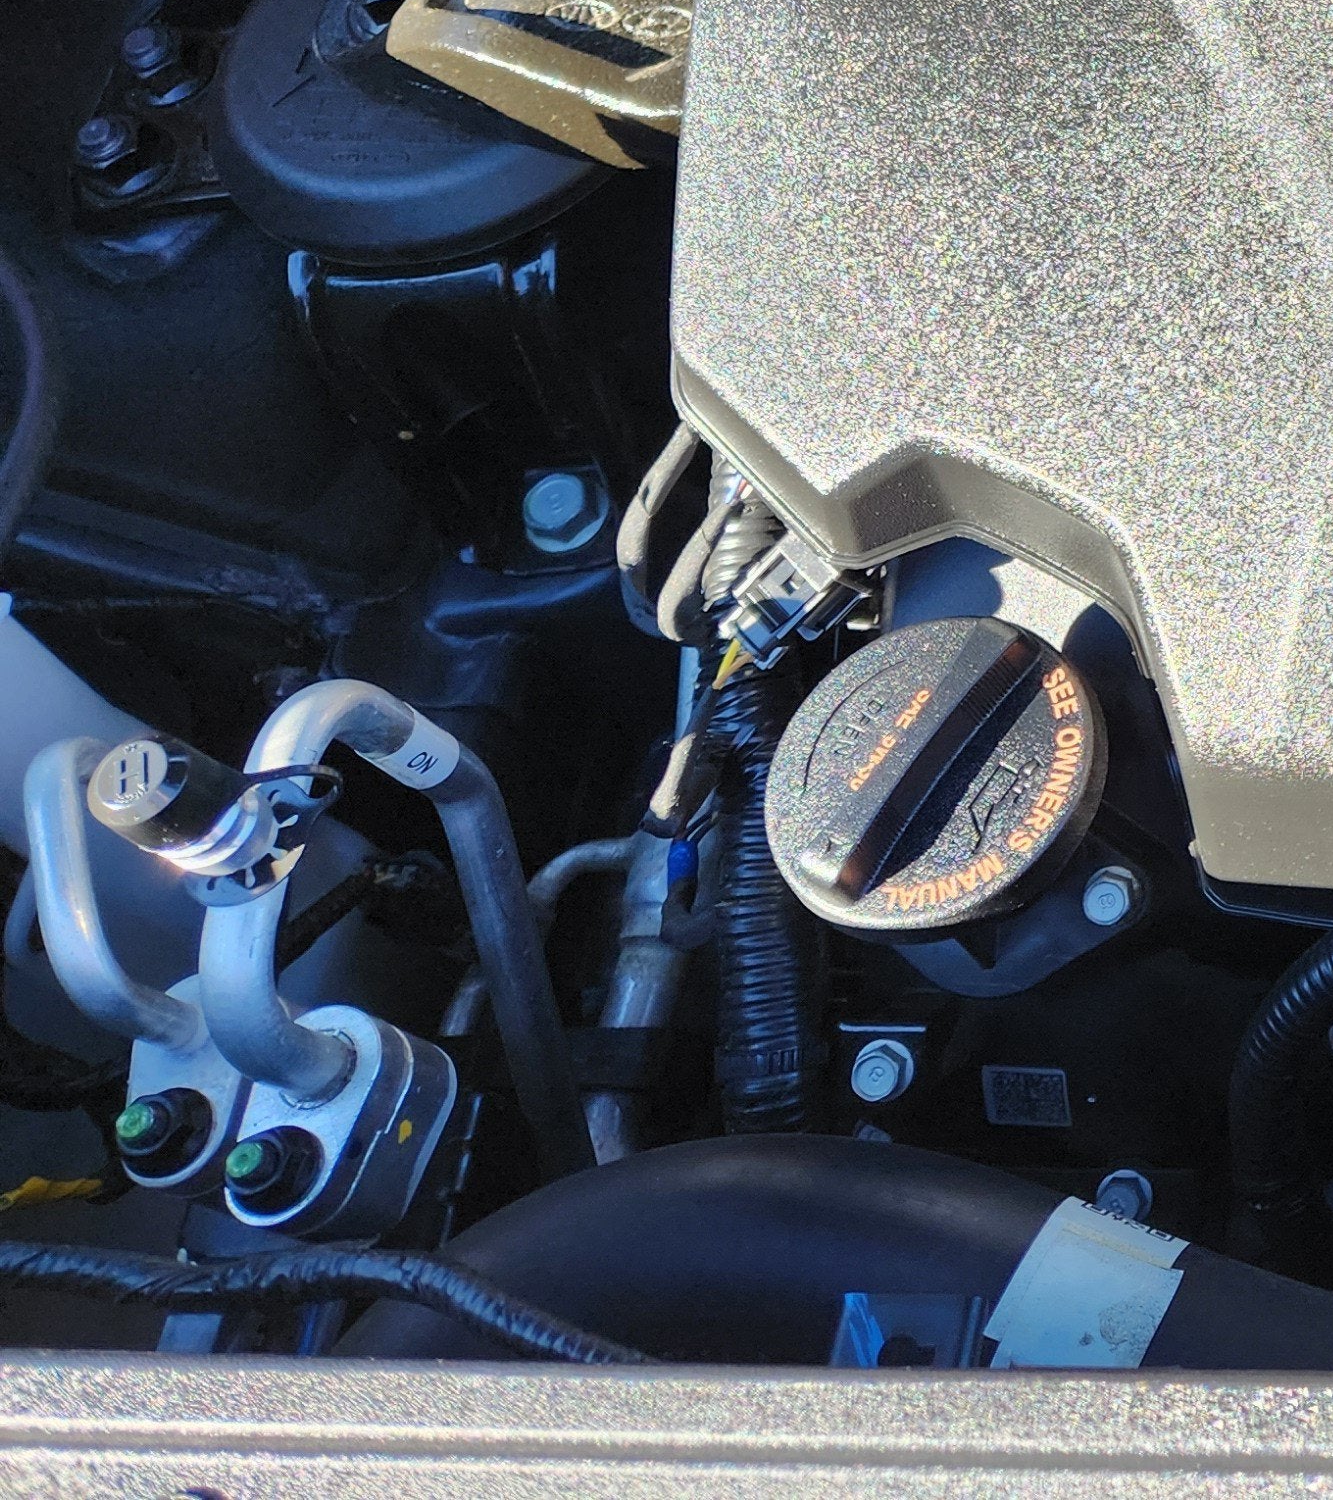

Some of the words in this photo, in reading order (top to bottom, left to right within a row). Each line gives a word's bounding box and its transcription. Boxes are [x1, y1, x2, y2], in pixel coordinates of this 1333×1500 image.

[1042, 667, 1080, 719] SEE
[1007, 726, 1083, 851] OWNER'S
[880, 853, 1005, 912] MANUAL
